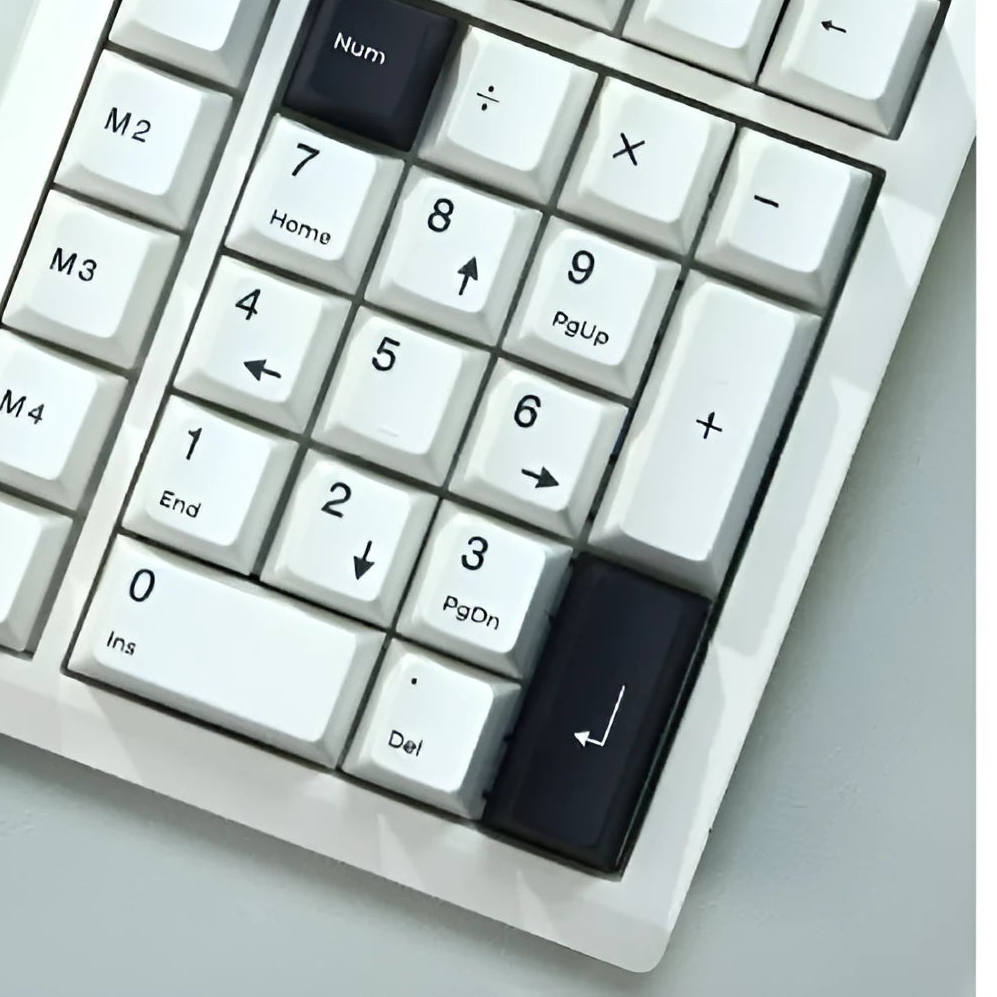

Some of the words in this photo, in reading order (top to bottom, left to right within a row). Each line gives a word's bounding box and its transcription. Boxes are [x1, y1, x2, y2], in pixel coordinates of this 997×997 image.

[334, 33, 385, 64] Num
[104, 107, 151, 142] M2
[291, 143, 320, 176] 7
[270, 209, 331, 245] Home
[428, 198, 454, 232] 8
[50, 248, 97, 281] M3
[568, 250, 594, 284] 9
[235, 289, 260, 320] 4
[553, 311, 609, 346] PgUp
[372, 337, 400, 371] 5
[0, 389, 44, 424] M4
[514, 395, 541, 428] 6
[186, 428, 202, 460] 1
[160, 490, 201, 518] End
[321, 482, 351, 518] 2
[462, 536, 488, 570] 3
[129, 569, 155, 602] 0
[443, 595, 499, 630] PgDn
[107, 631, 136, 655] Ins
[389, 730, 423, 756] Del
